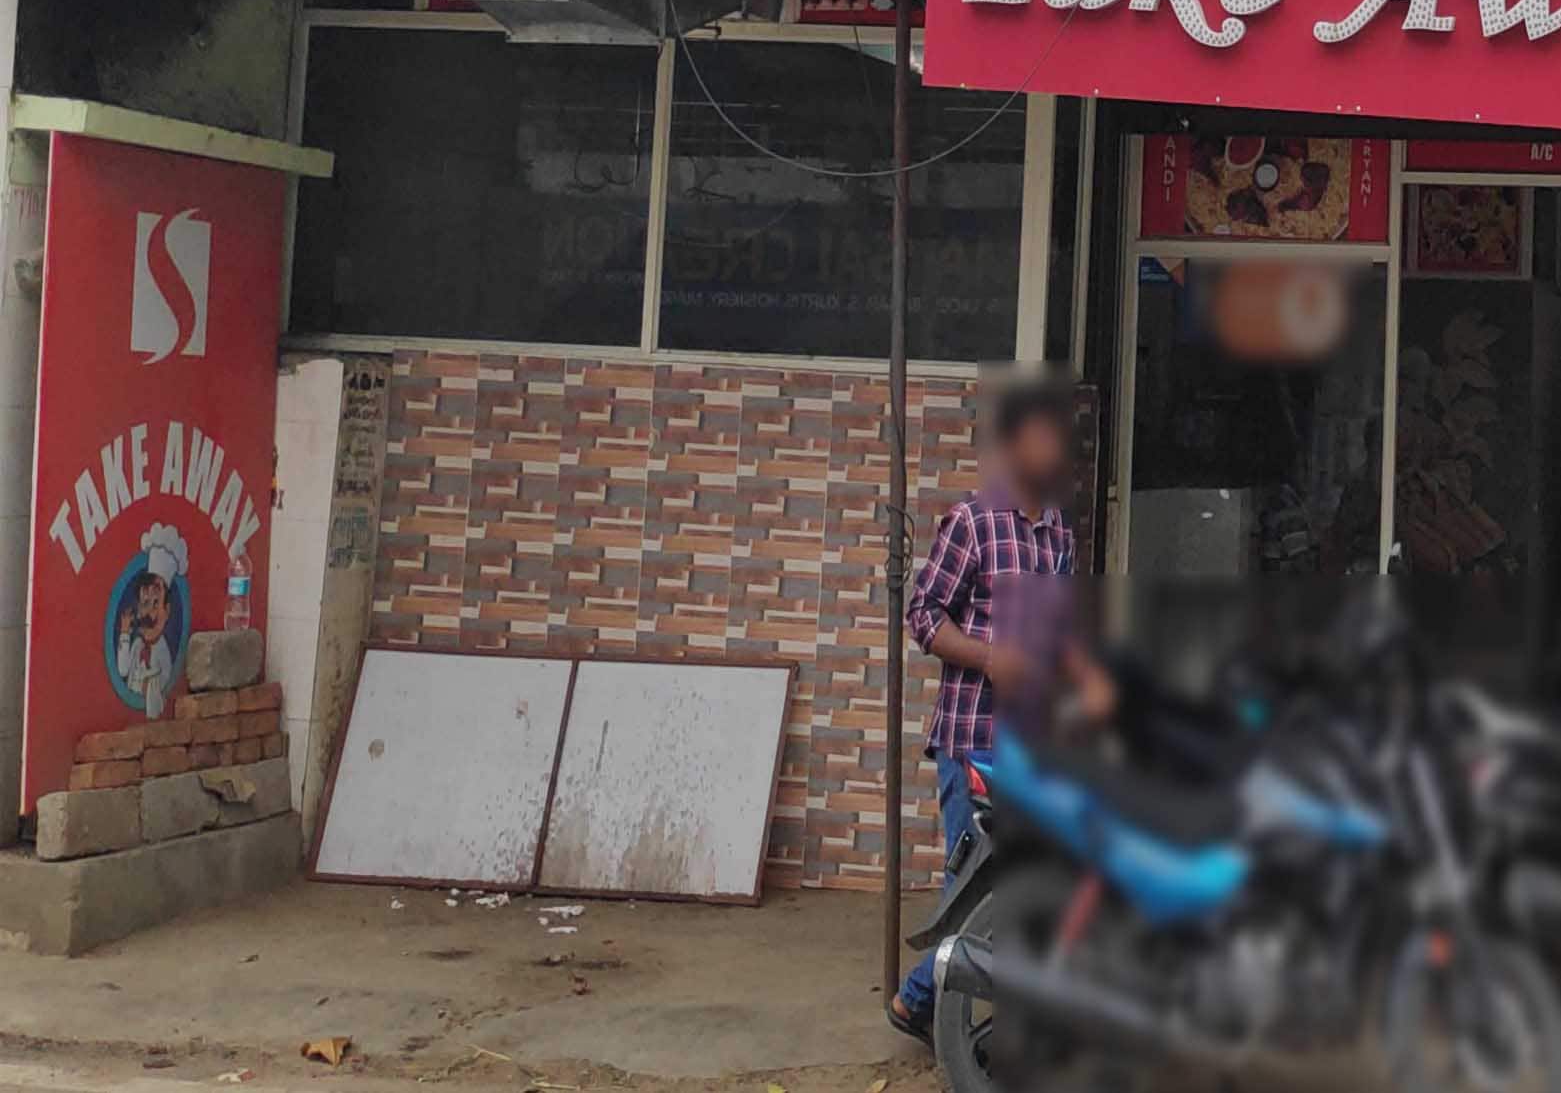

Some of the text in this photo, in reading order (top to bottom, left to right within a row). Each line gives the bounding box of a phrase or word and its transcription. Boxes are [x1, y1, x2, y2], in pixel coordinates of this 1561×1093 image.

[1163, 134, 1177, 203] ANDI
[1360, 139, 1374, 210] RYANI
[1530, 142, 1553, 161] A/C
[49, 423, 150, 576] TAKE
[160, 420, 262, 559] AWAY
